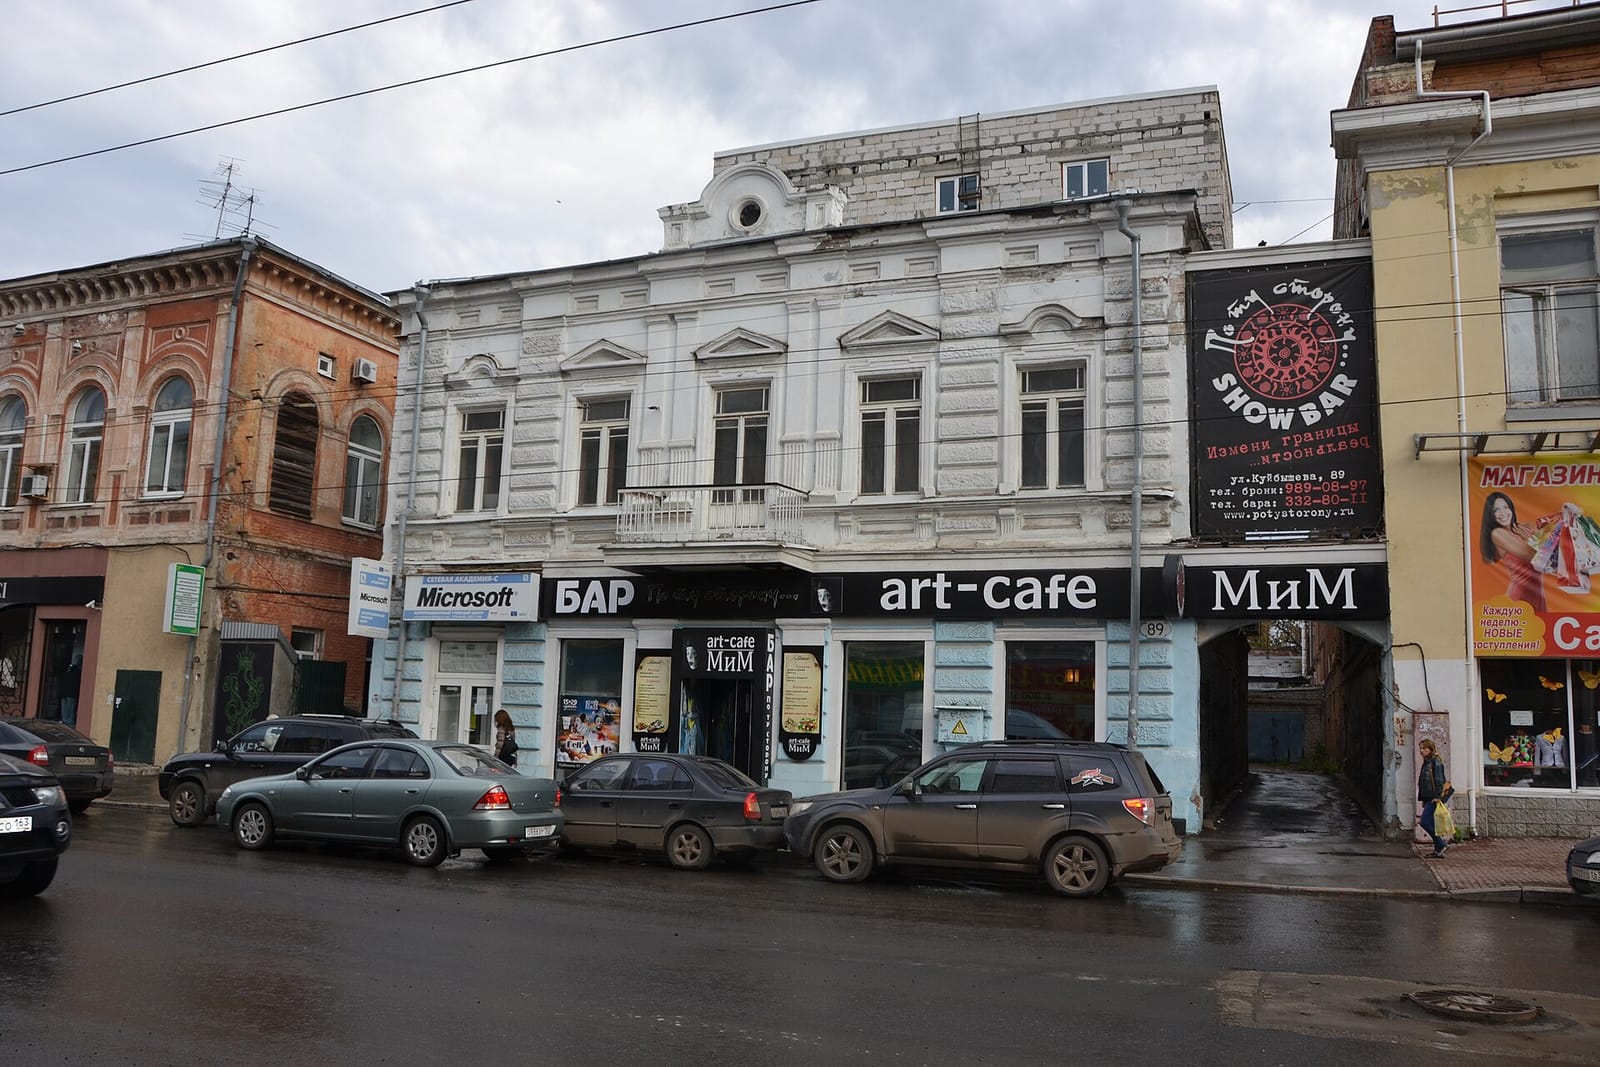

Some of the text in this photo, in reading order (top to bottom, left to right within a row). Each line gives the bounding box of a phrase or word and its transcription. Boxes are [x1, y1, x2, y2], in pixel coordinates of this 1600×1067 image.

[1212, 373, 1358, 430] SHOW BAR
[1207, 423, 1360, 460] Измени границы
[1330, 470, 1345, 480] 89
[1480, 463, 1600, 488] МАГАЗИН
[1210, 488, 1235, 496] тел.
[1285, 480, 1367, 494] 989-08-97
[1210, 500, 1235, 509] тел.
[1242, 499, 1277, 511] бара:
[1224, 508, 1354, 520] www.potystorony.ru
[880, 573, 1097, 610] art-cafe
[1212, 568, 1358, 610] МиМ
[360, 592, 388, 605] Microsoft
[416, 586, 514, 608] Microsoft
[555, 580, 635, 613] БАР
[1483, 606, 1522, 617] Каждую
[1147, 622, 1164, 636] 89
[1480, 618, 1519, 627] неделю
[1484, 628, 1523, 638] НОВЫЕ
[707, 635, 755, 649] art-cafe
[706, 651, 753, 672] МиМ
[766, 633, 774, 692] БАР
[640, 743, 660, 752] МиМ
[788, 744, 810, 753] МиМ
